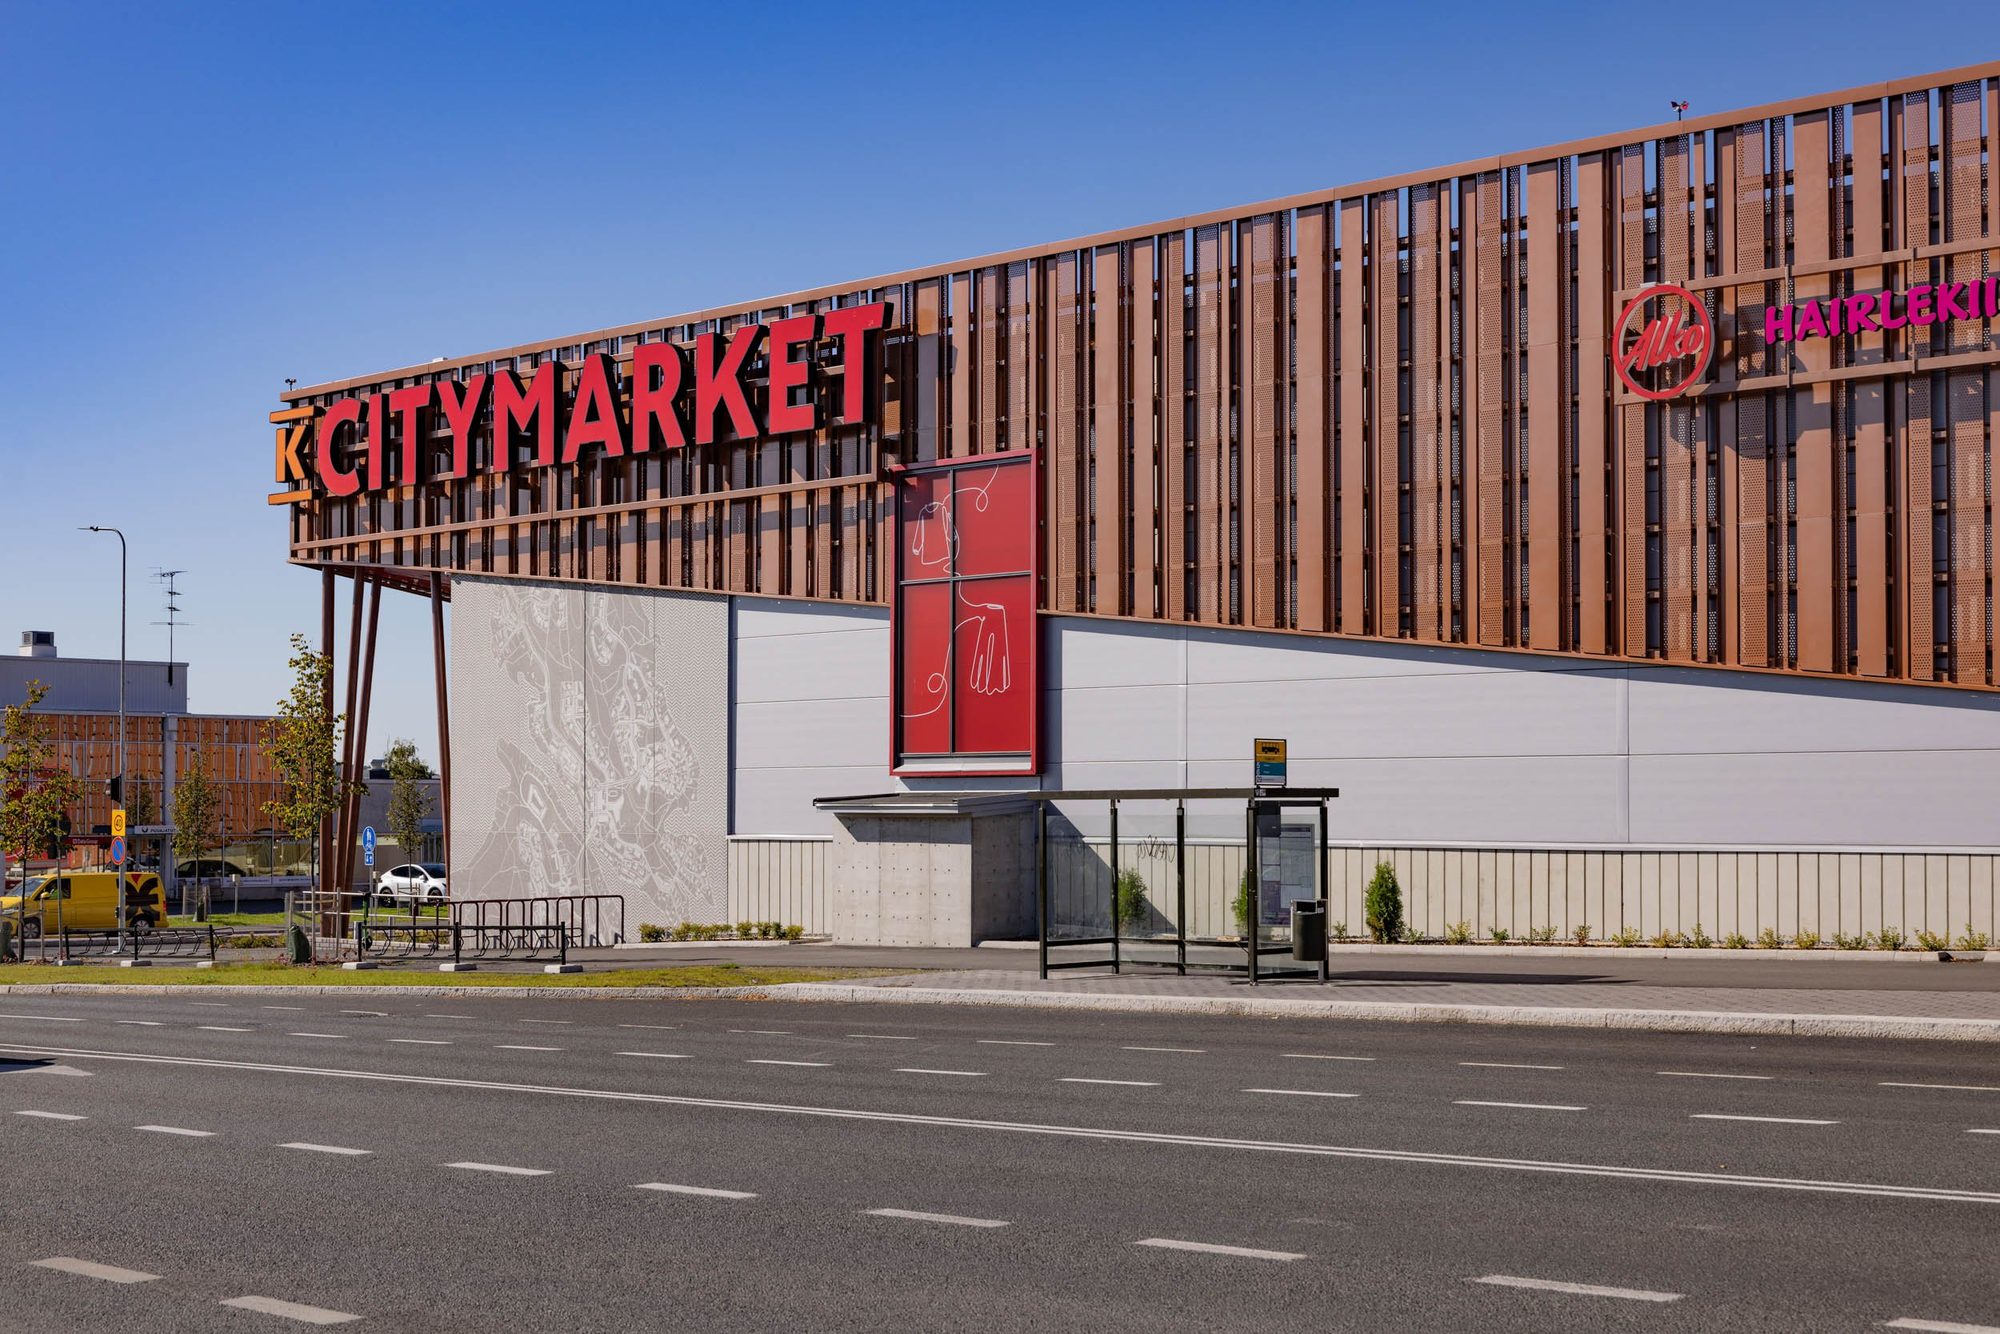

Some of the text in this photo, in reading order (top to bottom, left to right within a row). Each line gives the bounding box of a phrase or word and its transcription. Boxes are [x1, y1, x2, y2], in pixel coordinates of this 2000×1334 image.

[276, 302, 890, 497] K CITYMARKET
[1622, 310, 1705, 371] Alko
